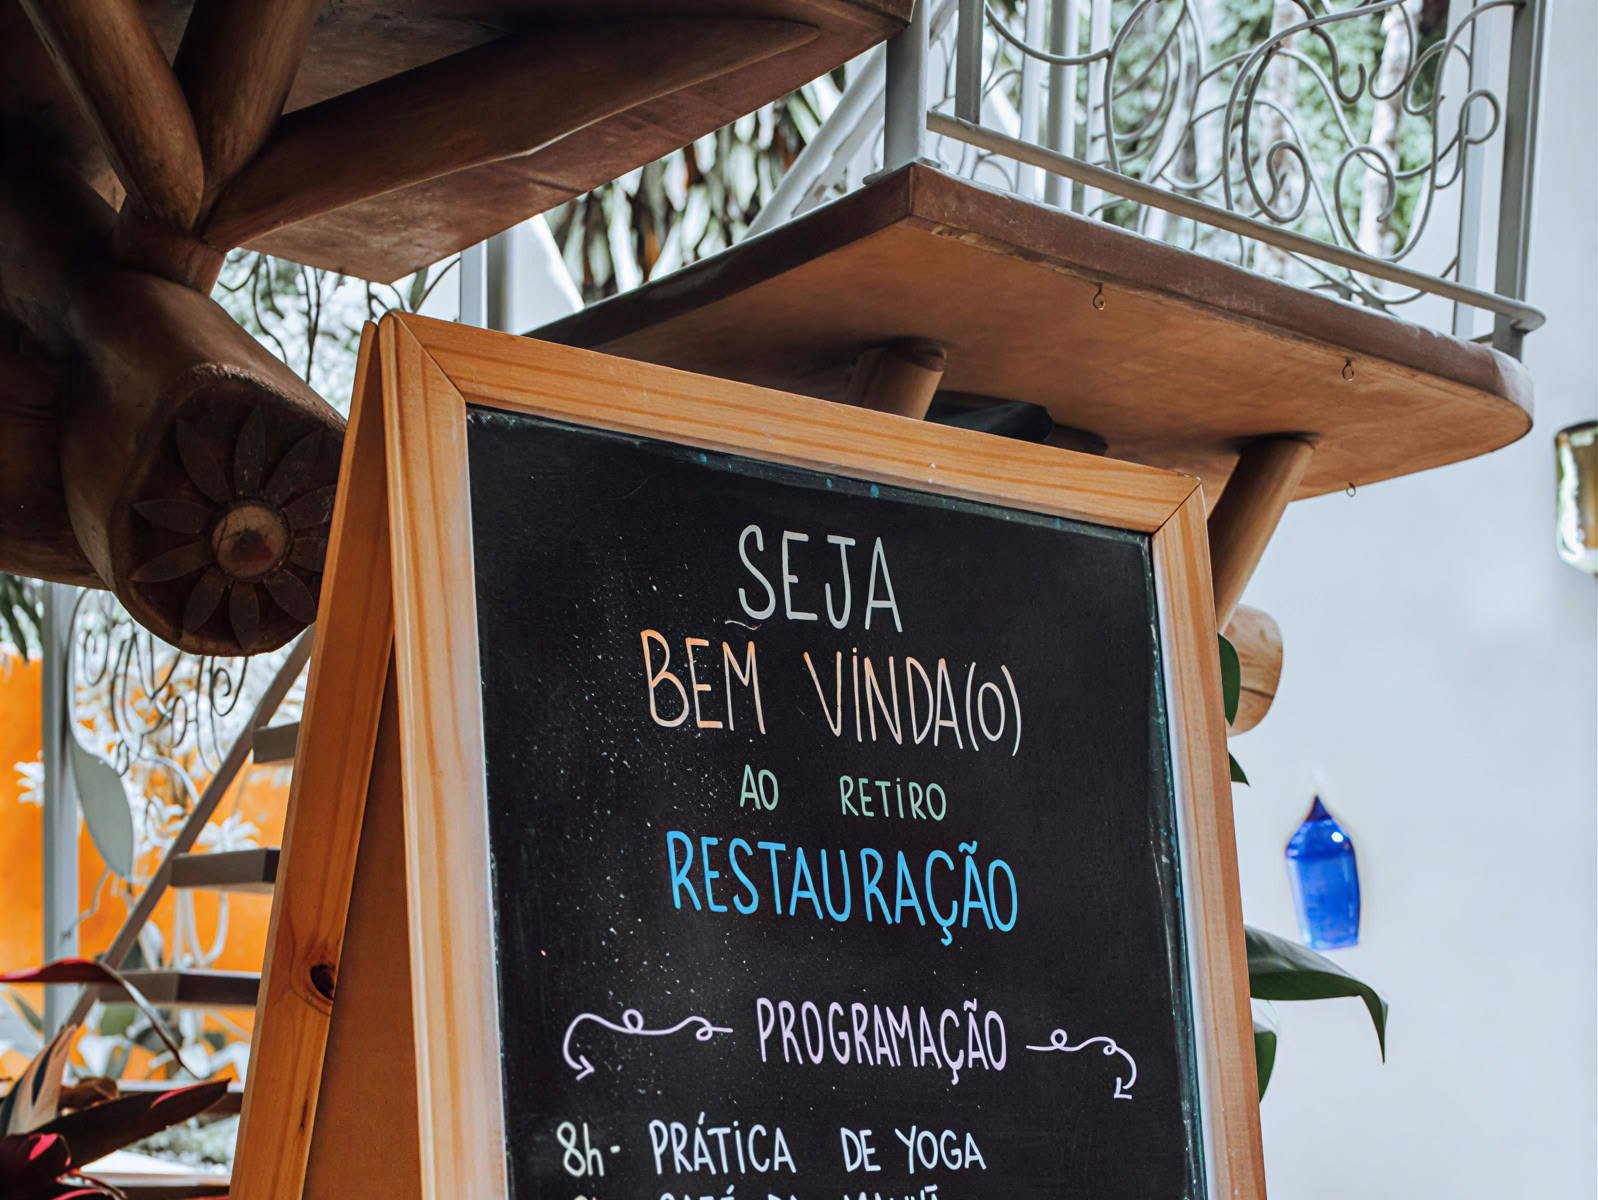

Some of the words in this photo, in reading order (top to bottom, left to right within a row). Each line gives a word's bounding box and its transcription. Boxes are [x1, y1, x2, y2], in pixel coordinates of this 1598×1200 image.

[734, 524, 903, 633] SEJA
[640, 628, 766, 735] BEM
[739, 764, 779, 811] AO
[839, 775, 947, 822] RETIRO
[666, 830, 1018, 947] RESTAURAÇÃO
[756, 997, 1007, 1086] PROGRAMAÇÃO
[648, 1111, 797, 1176] PRÁTICA
[839, 1127, 882, 1173] DE
[894, 1124, 987, 1174] YOGA
